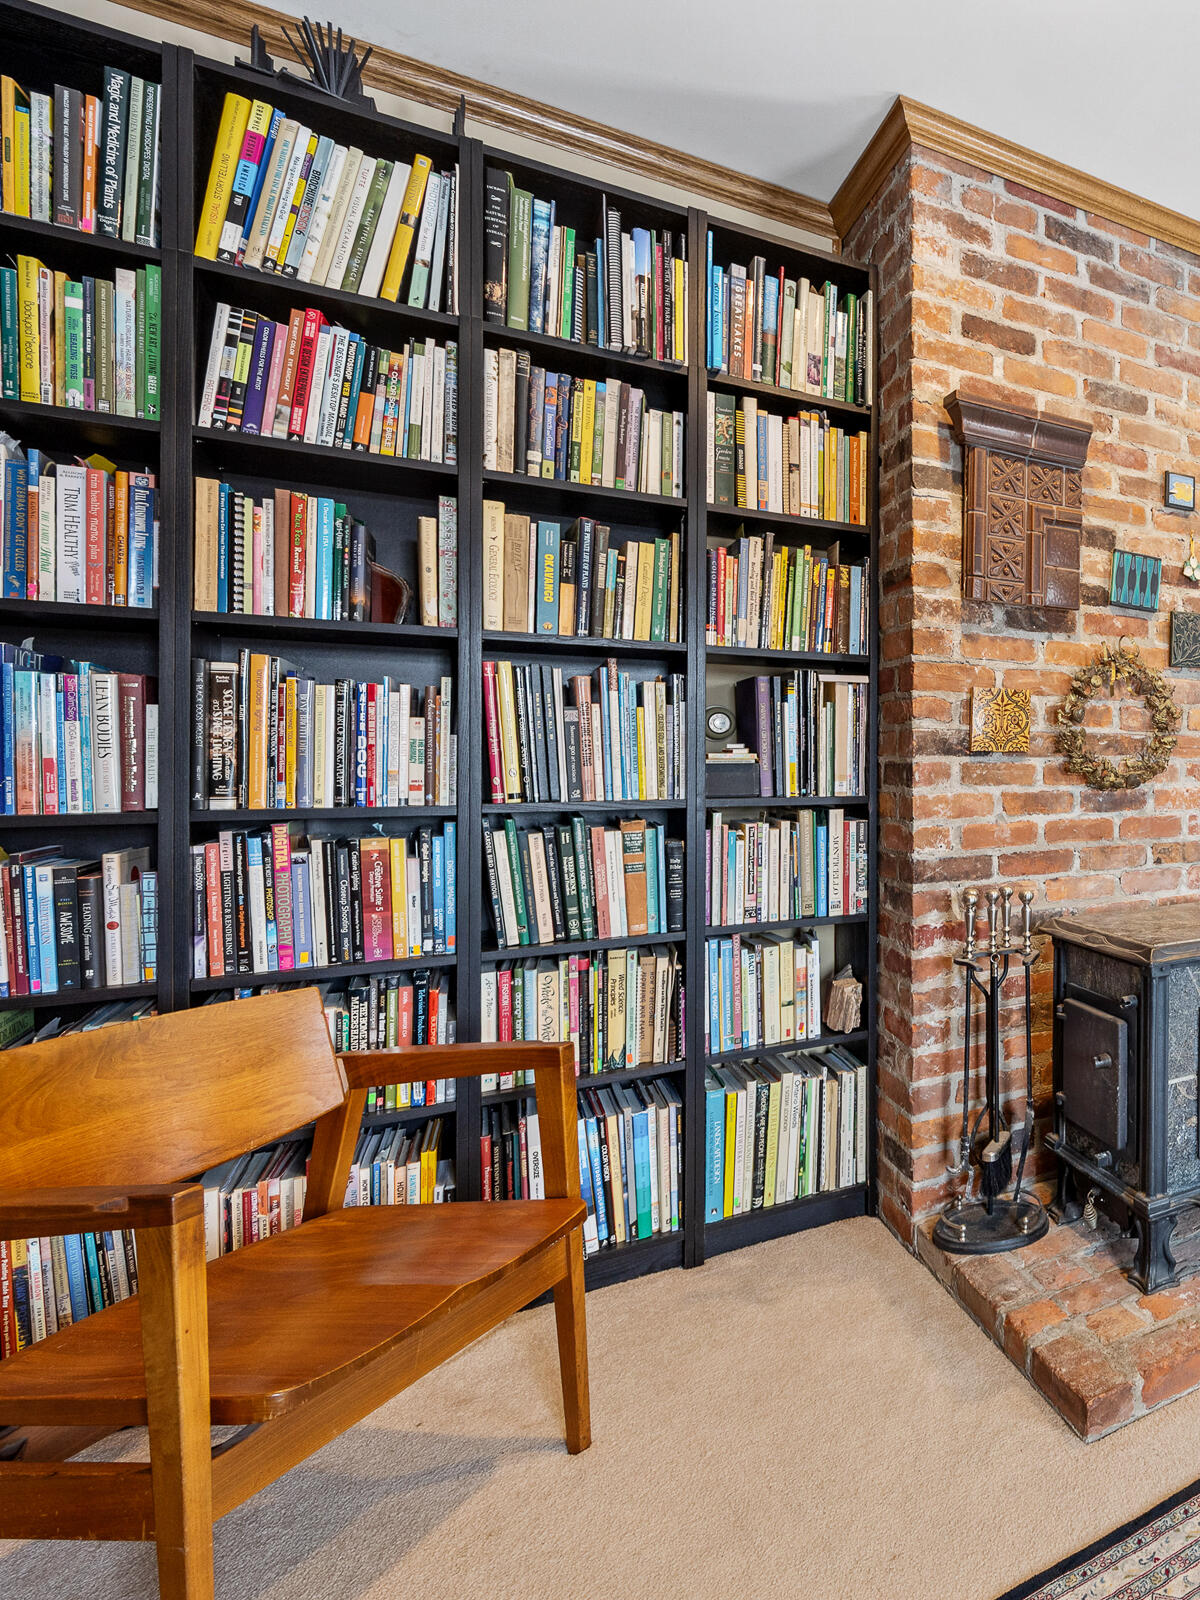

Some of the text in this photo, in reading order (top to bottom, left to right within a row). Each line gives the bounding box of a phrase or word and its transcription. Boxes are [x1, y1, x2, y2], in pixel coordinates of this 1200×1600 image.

[144, 86, 153, 125] REPRESENTING
[104, 73, 123, 208] Magic and Medicine of Plants
[233, 105, 264, 206] GRAPHIC DESIGN AMERICA TWO
[209, 154, 230, 224] VISUAL STORYTELLING
[334, 168, 369, 269] TUFTE VISUAL EXPLANATIONS
[349, 169, 385, 282] TUFTE BEAUTIFUL EVIDENCE
[23, 300, 35, 336] Backyard
[735, 286, 743, 323] GREAT
[148, 322, 157, 335] NEW
[262, 327, 270, 341] COLOR
[305, 338, 313, 348] THE
[70, 364, 78, 380] WISE
[148, 354, 156, 374] LIVING
[302, 349, 311, 367] DESIGN
[346, 342, 357, 380] PHOTOSHOP
[148, 375, 156, 394] GREEN
[202, 379, 214, 411] PATTERNS
[284, 368, 292, 390] ASHCRAFT
[296, 368, 308, 406] ENTREPRENEUR
[326, 335, 346, 437] THE DESIGNER'S DESKTOP MANUAL
[390, 371, 398, 395] COLOR
[486, 372, 494, 408] HONEYBEE
[339, 397, 348, 418] MAGIC
[386, 398, 395, 426] SCHEME
[384, 427, 393, 447] BIBLE
[87, 490, 99, 515] healthy
[15, 469, 26, 572] WHY ZEBRAS DON'T GET ULCERS
[64, 488, 80, 559] TRIM HEALTHY
[336, 518, 344, 549] Agri-Quest
[87, 544, 98, 560] plan
[444, 501, 452, 593] SEW SERENDIPITY
[488, 544, 499, 600] GENERAL ECOLOGY
[544, 554, 554, 602] OKAVANGO
[195, 704, 203, 721] DOGS
[223, 689, 233, 716] SCENE
[68, 722, 76, 740] YOGA
[95, 679, 113, 759] LEAN BODIES
[213, 711, 222, 737] STAGE
[337, 727, 344, 735] OF
[357, 683, 367, 778] WATER DOG
[223, 720, 233, 752] DESIGN
[336, 736, 344, 763] RAISING
[212, 739, 222, 780] LIGHTING
[336, 767, 344, 787] PUPPY
[223, 873, 231, 908] LIGHTING
[274, 826, 291, 945] DIGITAL PHOTOGRAPHY
[374, 861, 383, 888] Creative
[489, 869, 497, 899] BEHAVIOUR
[340, 880, 350, 933] Closeup Shooting
[60, 912, 74, 944] AWESOME
[792, 1080, 801, 1105] Ontario
